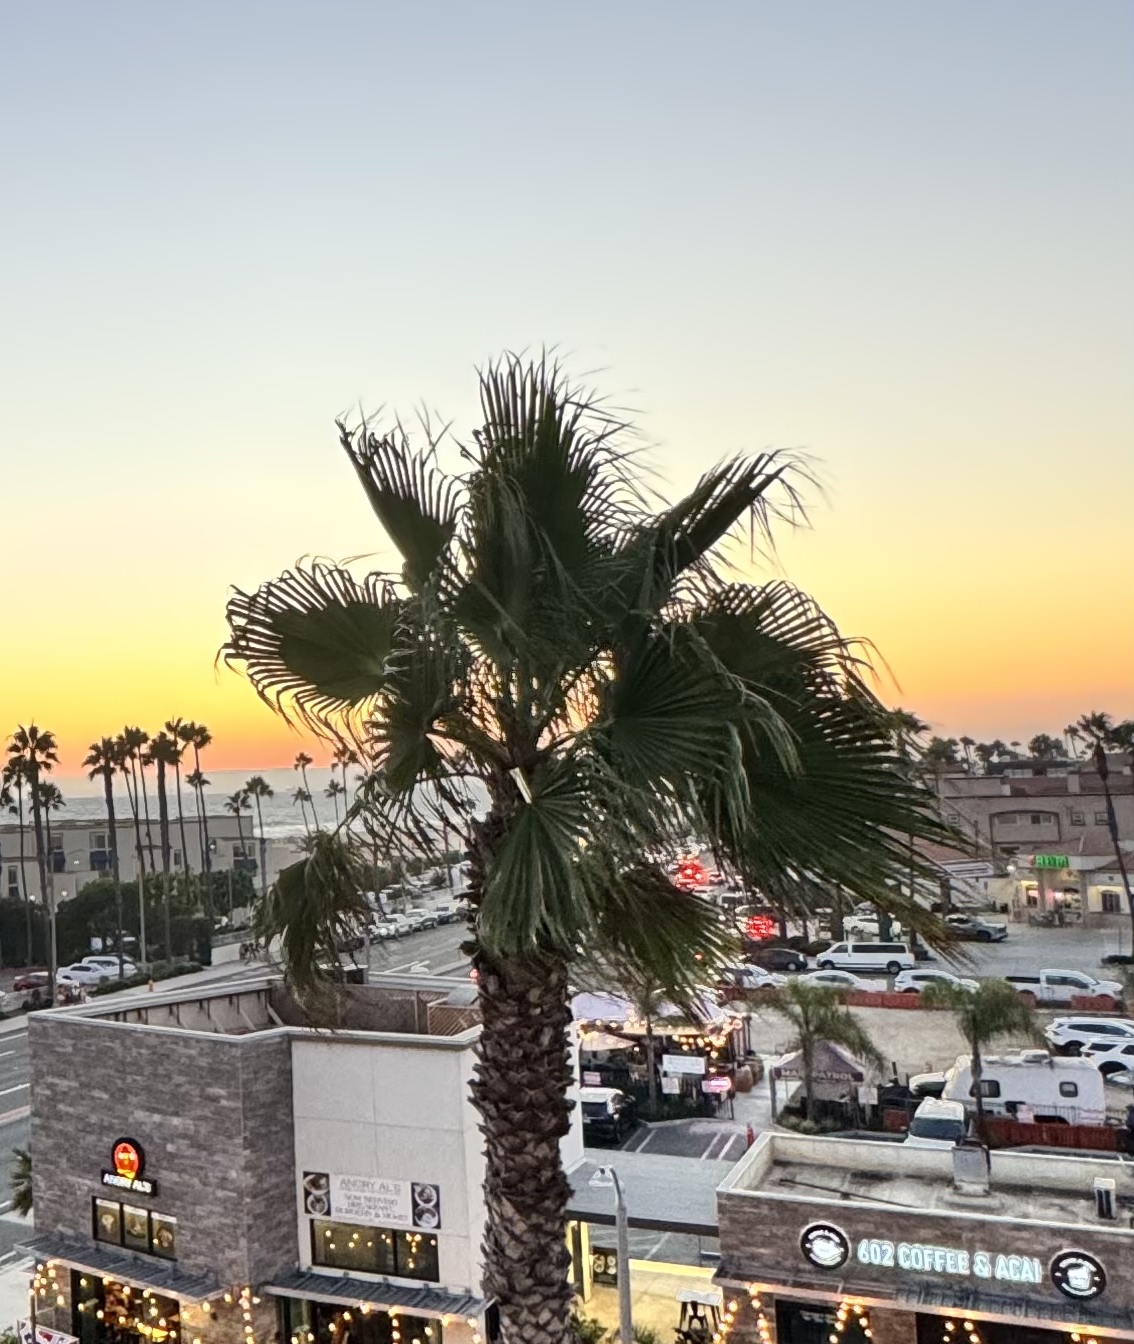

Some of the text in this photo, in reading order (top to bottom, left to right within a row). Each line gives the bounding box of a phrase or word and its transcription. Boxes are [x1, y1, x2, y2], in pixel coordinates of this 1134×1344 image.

[857, 1239, 894, 1267] 602
[897, 1242, 970, 1275] COFFEE
[973, 1251, 991, 1278] &
[995, 1254, 1042, 1283] ACAI
